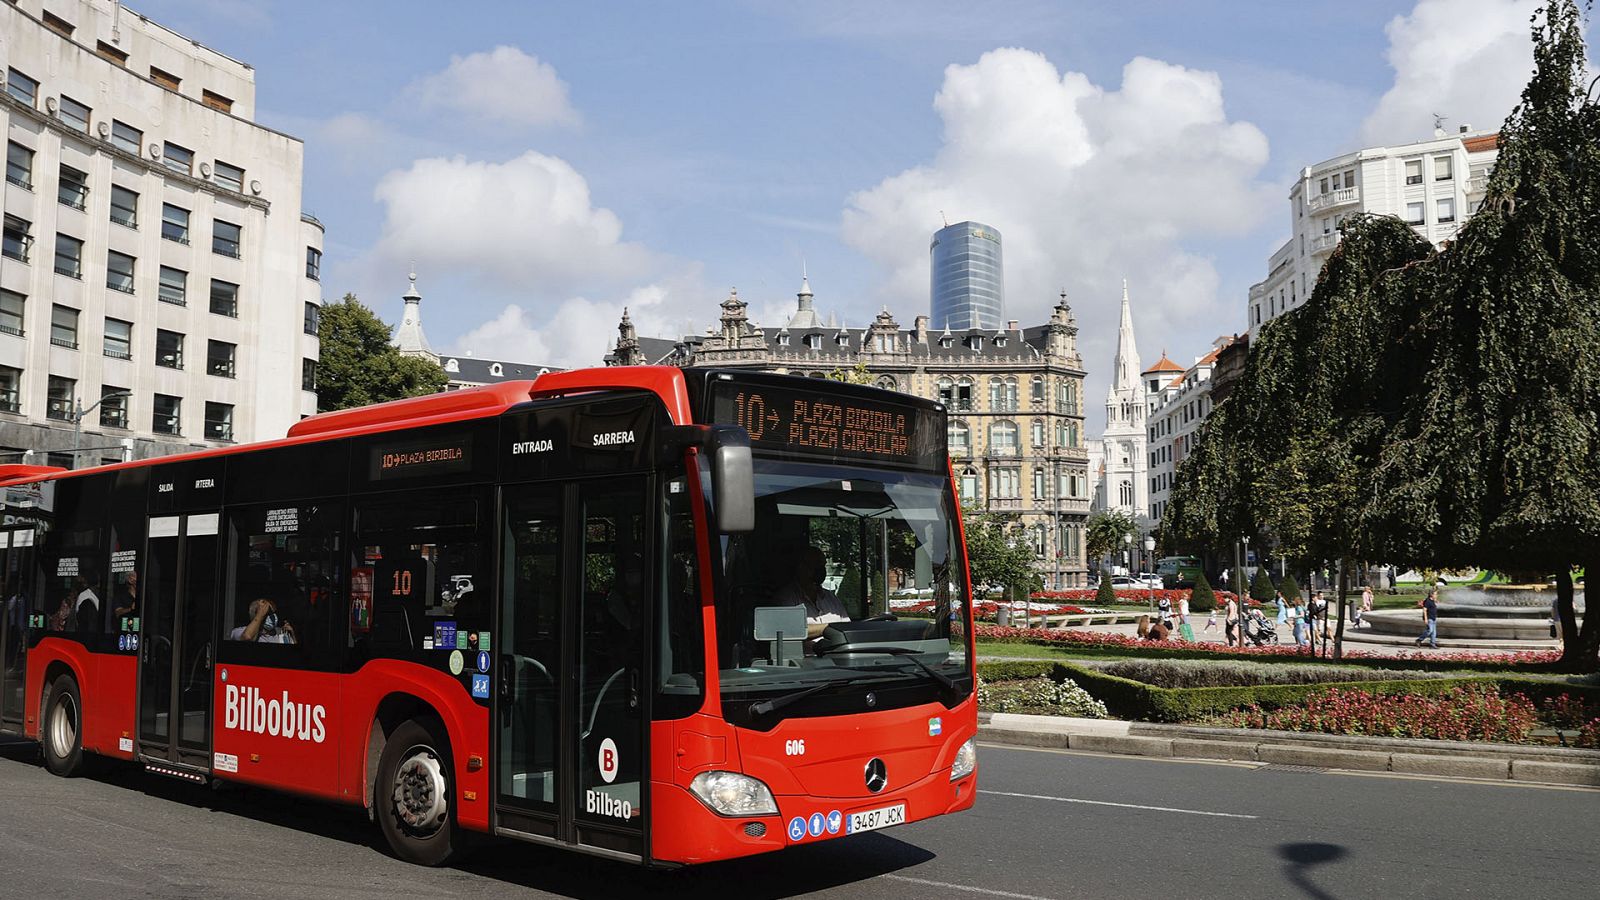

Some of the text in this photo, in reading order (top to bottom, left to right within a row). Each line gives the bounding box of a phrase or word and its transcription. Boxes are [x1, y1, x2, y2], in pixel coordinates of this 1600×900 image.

[736, 392, 765, 440] 10
[793, 401, 905, 434] PLAZA BIRIBILA
[512, 439, 553, 455] ENTRADA
[593, 430, 635, 446] SARRERA
[789, 422, 907, 455] PLAZA CIRCULAR
[383, 447, 462, 468] 10 PLAZA BIRIBILA
[158, 483, 174, 493] SALIDA
[195, 478, 215, 489] IRTEERA
[392, 570, 412, 595] 10
[225, 684, 326, 743] Bilbobus
[785, 739, 805, 756] 606
[603, 749, 615, 772] B
[586, 789, 632, 820] Bilbao
[855, 806, 903, 830] 3487 JCK
